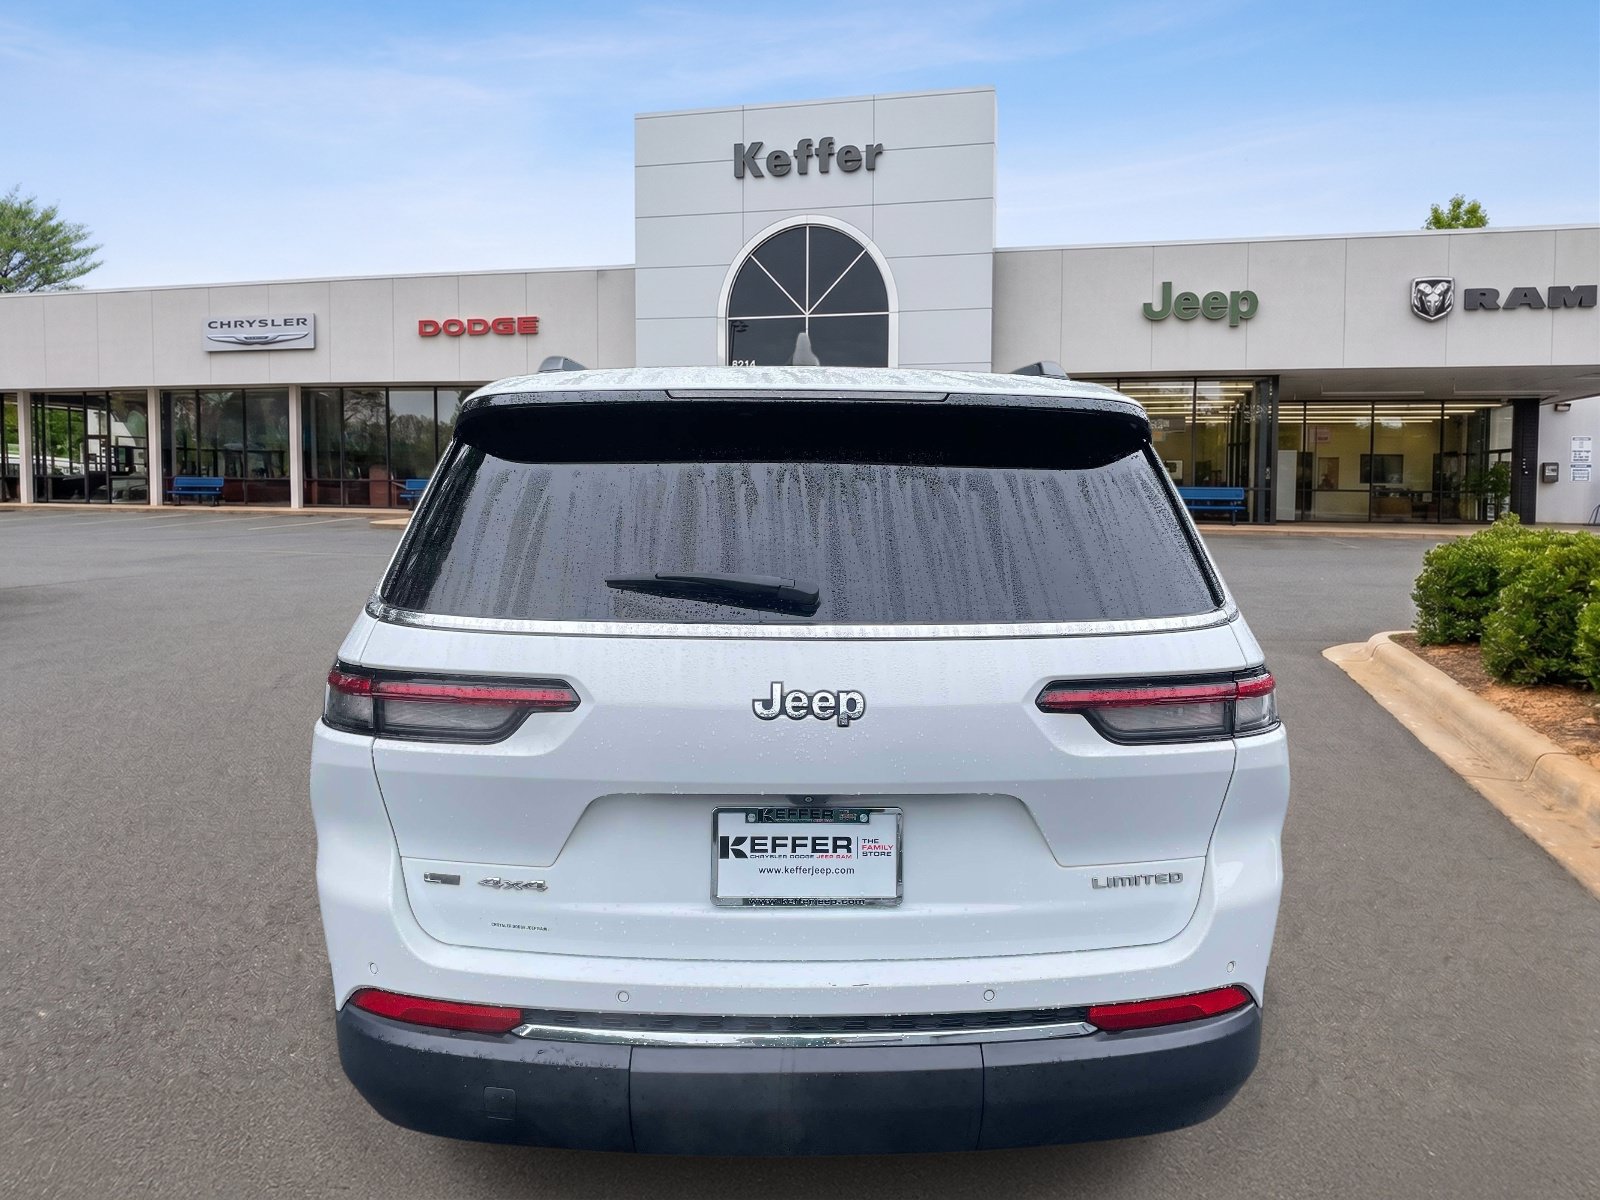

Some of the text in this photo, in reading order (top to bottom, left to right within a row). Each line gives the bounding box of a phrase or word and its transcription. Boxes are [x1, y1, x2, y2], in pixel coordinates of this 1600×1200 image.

[734, 136, 884, 179] Keffer
[1142, 281, 1260, 328] Jeep
[1463, 284, 1598, 311] RAM
[207, 317, 308, 330] CHRYSLER
[418, 316, 539, 337] DODGE
[752, 681, 866, 727] Jeep
[719, 835, 853, 860] KEFFER
[758, 865, 855, 876] www.kefferjeep.com
[1092, 872, 1184, 890] LIMITED
